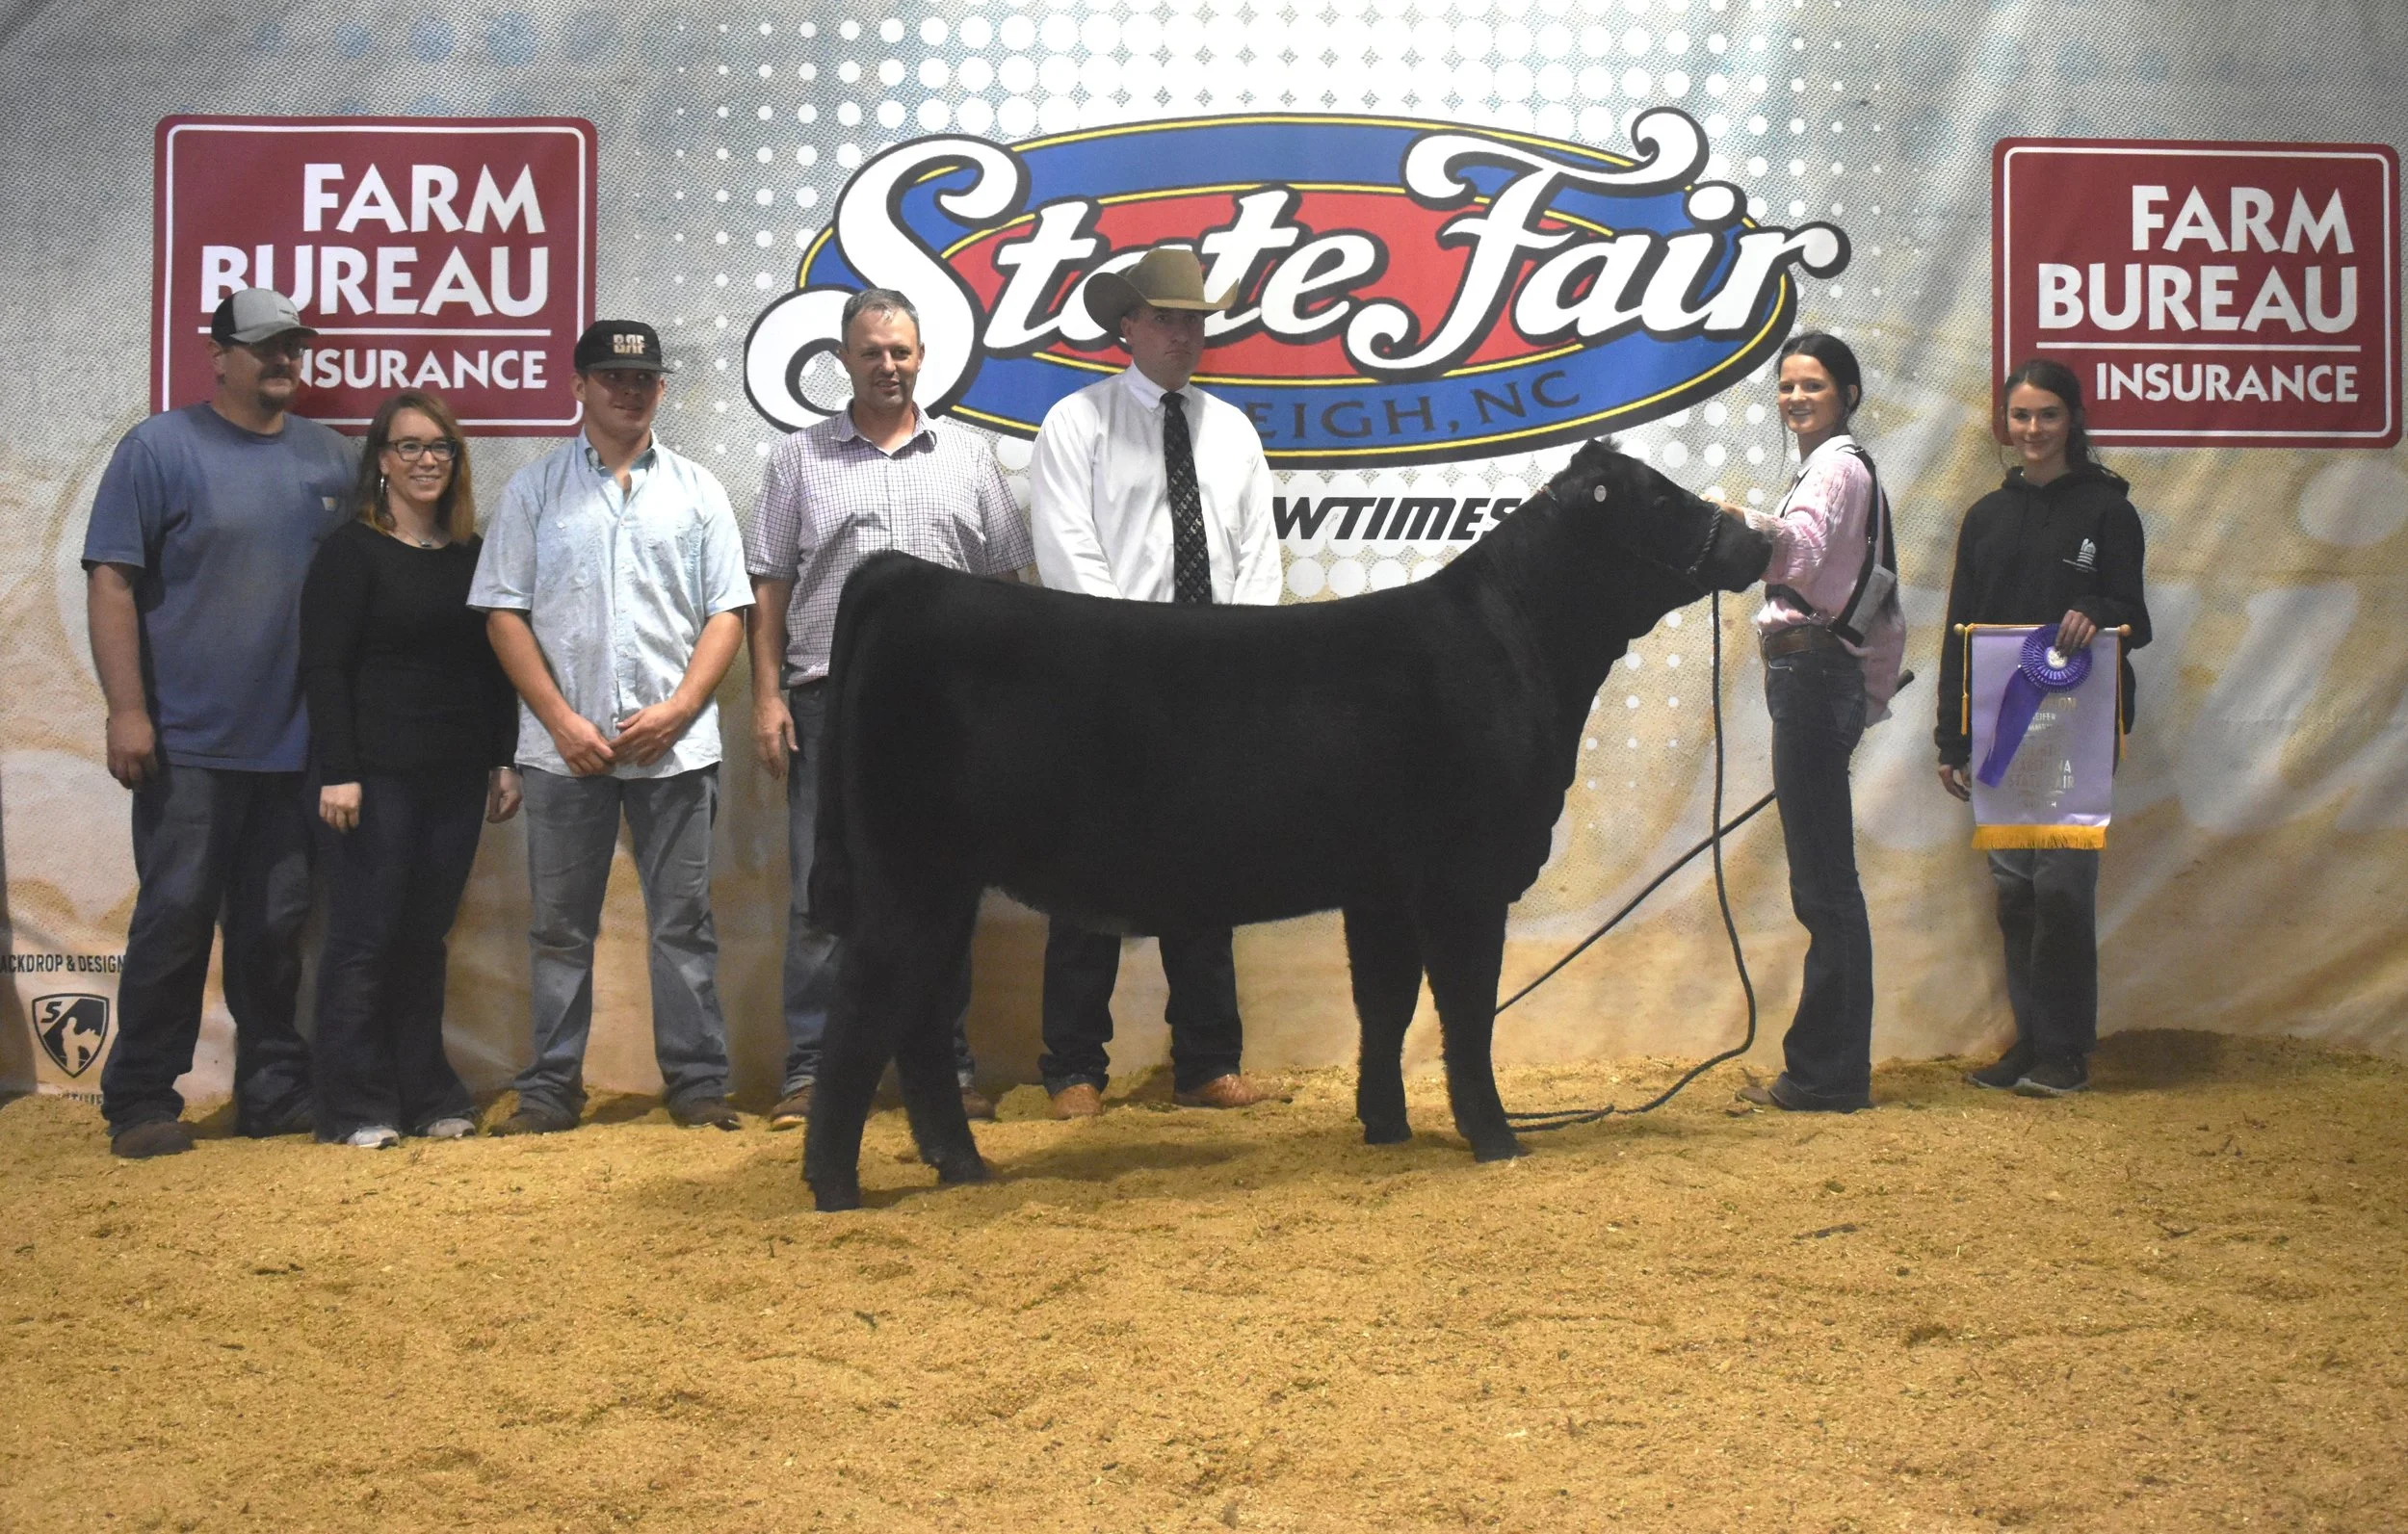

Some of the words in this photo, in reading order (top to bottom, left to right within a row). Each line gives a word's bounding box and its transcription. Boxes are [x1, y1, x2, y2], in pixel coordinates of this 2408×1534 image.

[302, 162, 546, 234] FARM
[2132, 184, 2355, 254] FARM
[1345, 110, 1844, 371] Fair
[199, 244, 549, 317] BUREAU
[2038, 262, 2358, 333] BUREAU
[300, 348, 548, 390] SURANCE
[2096, 362, 2359, 403] INSURANCE
[1244, 395, 1460, 440] EIGH,
[1470, 370, 1581, 425] NC
[1272, 496, 1523, 540] WTIMES
[0, 954, 64, 973] ACKDROP
[66, 955, 75, 973] &
